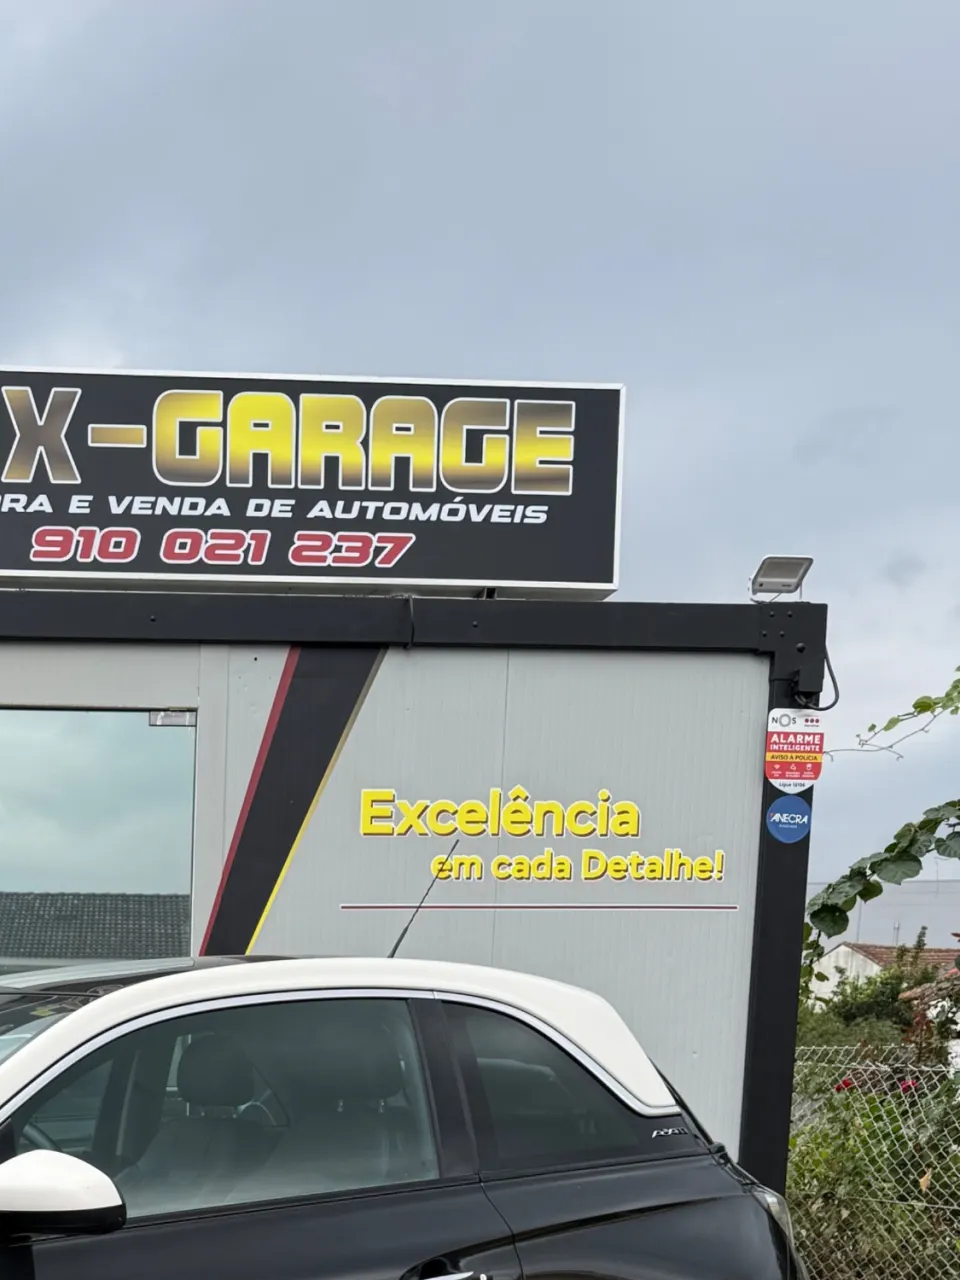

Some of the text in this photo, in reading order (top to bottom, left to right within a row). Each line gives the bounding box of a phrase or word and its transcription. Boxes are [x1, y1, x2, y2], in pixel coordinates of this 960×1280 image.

[68, 494, 93, 514] E
[108, 495, 231, 516] VENDA
[246, 498, 295, 518] DE
[306, 497, 549, 524] AUTOMÓVEIS
[30, 526, 416, 567] 910 021 237
[771, 713, 797, 727] NOS
[770, 733, 821, 744] ALARME
[770, 744, 820, 752] INTELIGENTE
[359, 785, 641, 837] Excelência
[770, 812, 809, 825] ANECRA
[431, 848, 724, 881] em cada Detalhe!
